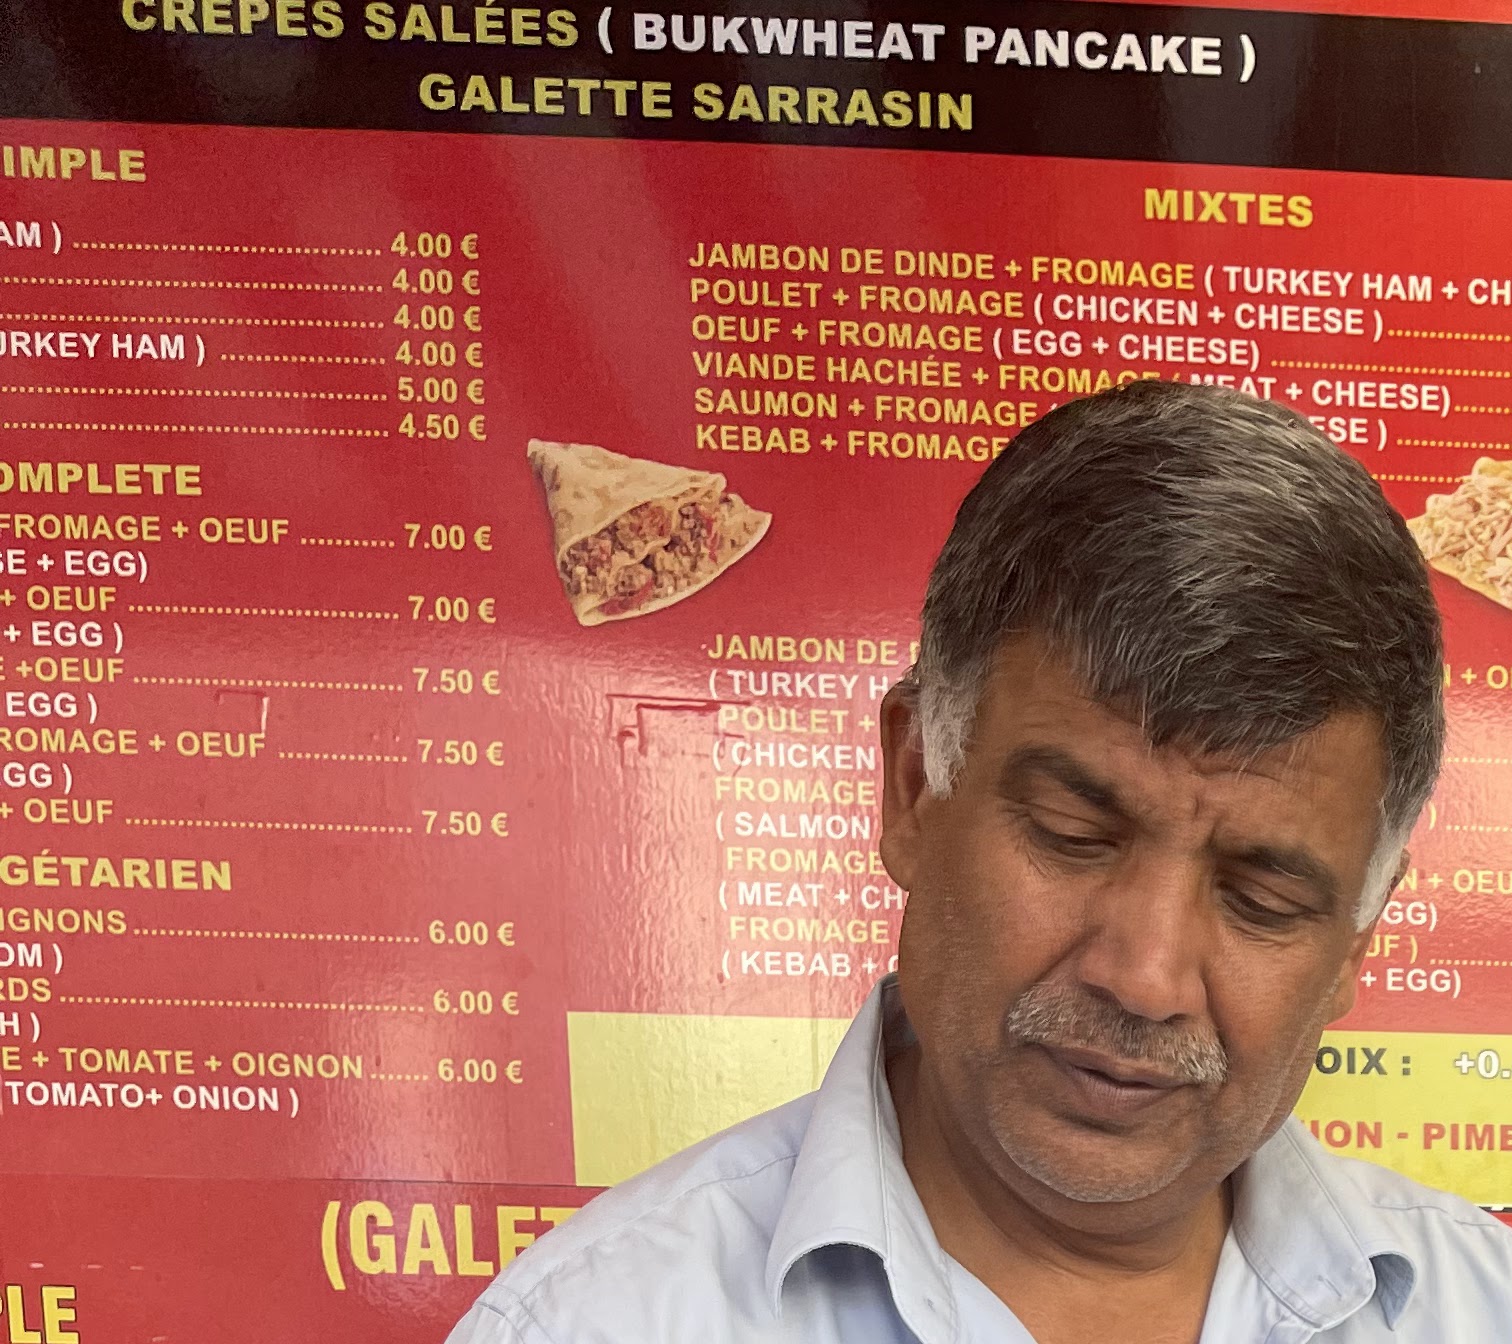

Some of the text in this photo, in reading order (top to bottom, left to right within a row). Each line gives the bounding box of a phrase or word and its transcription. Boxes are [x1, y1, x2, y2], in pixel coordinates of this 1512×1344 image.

[633, 12, 946, 62] BUKWHEAT
[964, 26, 1222, 76] PANCAKE
[419, 73, 973, 131] GALETTE SARRASIN
[3, 145, 146, 182] IMPLE
[1144, 188, 1313, 228] MIXTES
[390, 231, 452, 258] 4.00
[392, 267, 453, 295] 4.00
[688, 242, 829, 272] JAMBON
[840, 247, 884, 275] DE
[894, 250, 995, 280] DINDE
[1032, 256, 1195, 290] FROMAGE
[1222, 265, 1353, 298] TURKEY
[1362, 272, 1432, 302] HAM
[393, 303, 455, 331] 4.00
[690, 277, 823, 308] POULET
[859, 284, 1025, 318] FROMAGE
[1052, 294, 1198, 326] CHICKEN
[1234, 302, 1365, 335] CHEESE
[0, 330, 456, 367] URKEY HAM 4.00
[691, 314, 781, 343] OEUF
[819, 319, 984, 353] FROMAGE
[1012, 328, 1082, 358] EGG
[1118, 333, 1260, 373] CHEESE)
[397, 376, 458, 403] 5.00
[691, 350, 816, 382] VIANDE
[826, 354, 962, 388] HACHÉE
[998, 366, 1162, 395] FROMA
[1310, 380, 1452, 419] CHEESE)
[694, 387, 837, 419] SAUMON
[875, 395, 1038, 428] FROMAGE
[398, 412, 460, 440] 4.50
[696, 423, 812, 454] KEBAB
[0, 461, 202, 496] OMPLETE
[199, 517, 289, 544] OEUF
[404, 523, 466, 550] 7.00
[64, 550, 148, 584] EGG)
[26, 585, 469, 623] OEUF 7.00
[31, 620, 103, 647] EGG
[707, 634, 900, 666] JAMBON DE
[412, 667, 473, 695] 7.50
[726, 669, 860, 700] TURKEY
[5, 691, 78, 718] EGG
[719, 707, 849, 735] POULET
[0, 727, 478, 766] ROMAGE OEUF 7.50
[732, 742, 876, 772] CHICKEN
[715, 776, 877, 807] FROMAGE
[23, 798, 482, 836] OEUF 7.50
[735, 811, 872, 841] SALMON
[727, 846, 887, 876] FROMAGE
[738, 882, 825, 909] MEAT
[428, 919, 489, 946] 6.00
[730, 916, 890, 945] FROMAGE
[741, 951, 852, 977] KEBAB
[1386, 967, 1462, 999] EGG)
[433, 989, 493, 1015] 6.00
[58, 1047, 497, 1083] TOMATE OIGNON 6.00
[172, 1084, 279, 1112] ONION
[321, 1200, 582, 1291] (GALE
